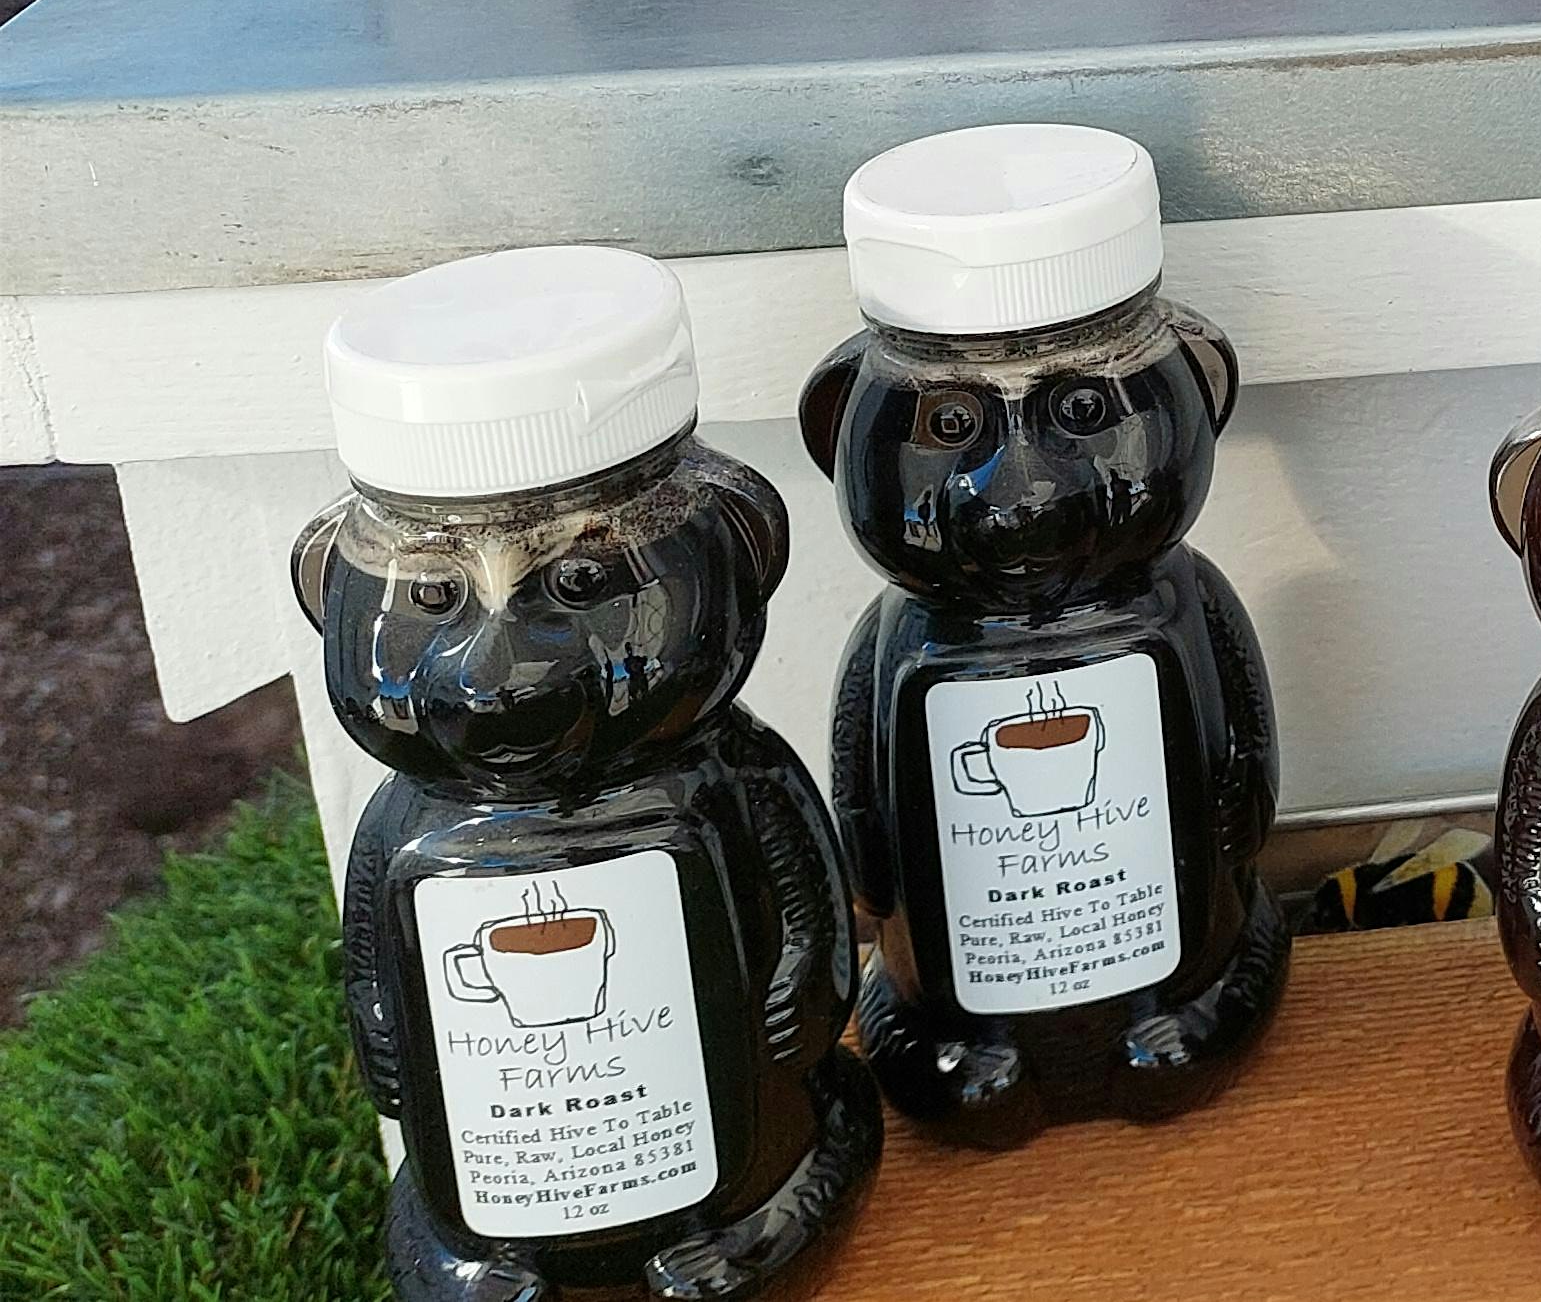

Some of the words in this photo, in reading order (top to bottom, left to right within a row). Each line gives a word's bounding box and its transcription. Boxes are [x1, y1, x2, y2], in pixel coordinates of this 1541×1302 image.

[951, 820, 1060, 852] Honey
[1078, 796, 1149, 831] Hive
[998, 842, 1109, 876] Farms
[988, 887, 1044, 902] Dark
[1057, 869, 1127, 895] Roast
[969, 940, 1165, 984] HoneyHiveFarms.com
[449, 1031, 567, 1065] Honey
[586, 1006, 673, 1043] Hive
[500, 1056, 626, 1090] Farms
[461, 1128, 541, 1145] Certified
[550, 1124, 597, 1142] Hive
[603, 1119, 629, 1132] To
[637, 1101, 693, 1125] Table
[491, 1103, 552, 1118] Dark
[566, 1084, 647, 1112] Roast
[475, 1161, 697, 1207] HoneyHiveFarms.com
